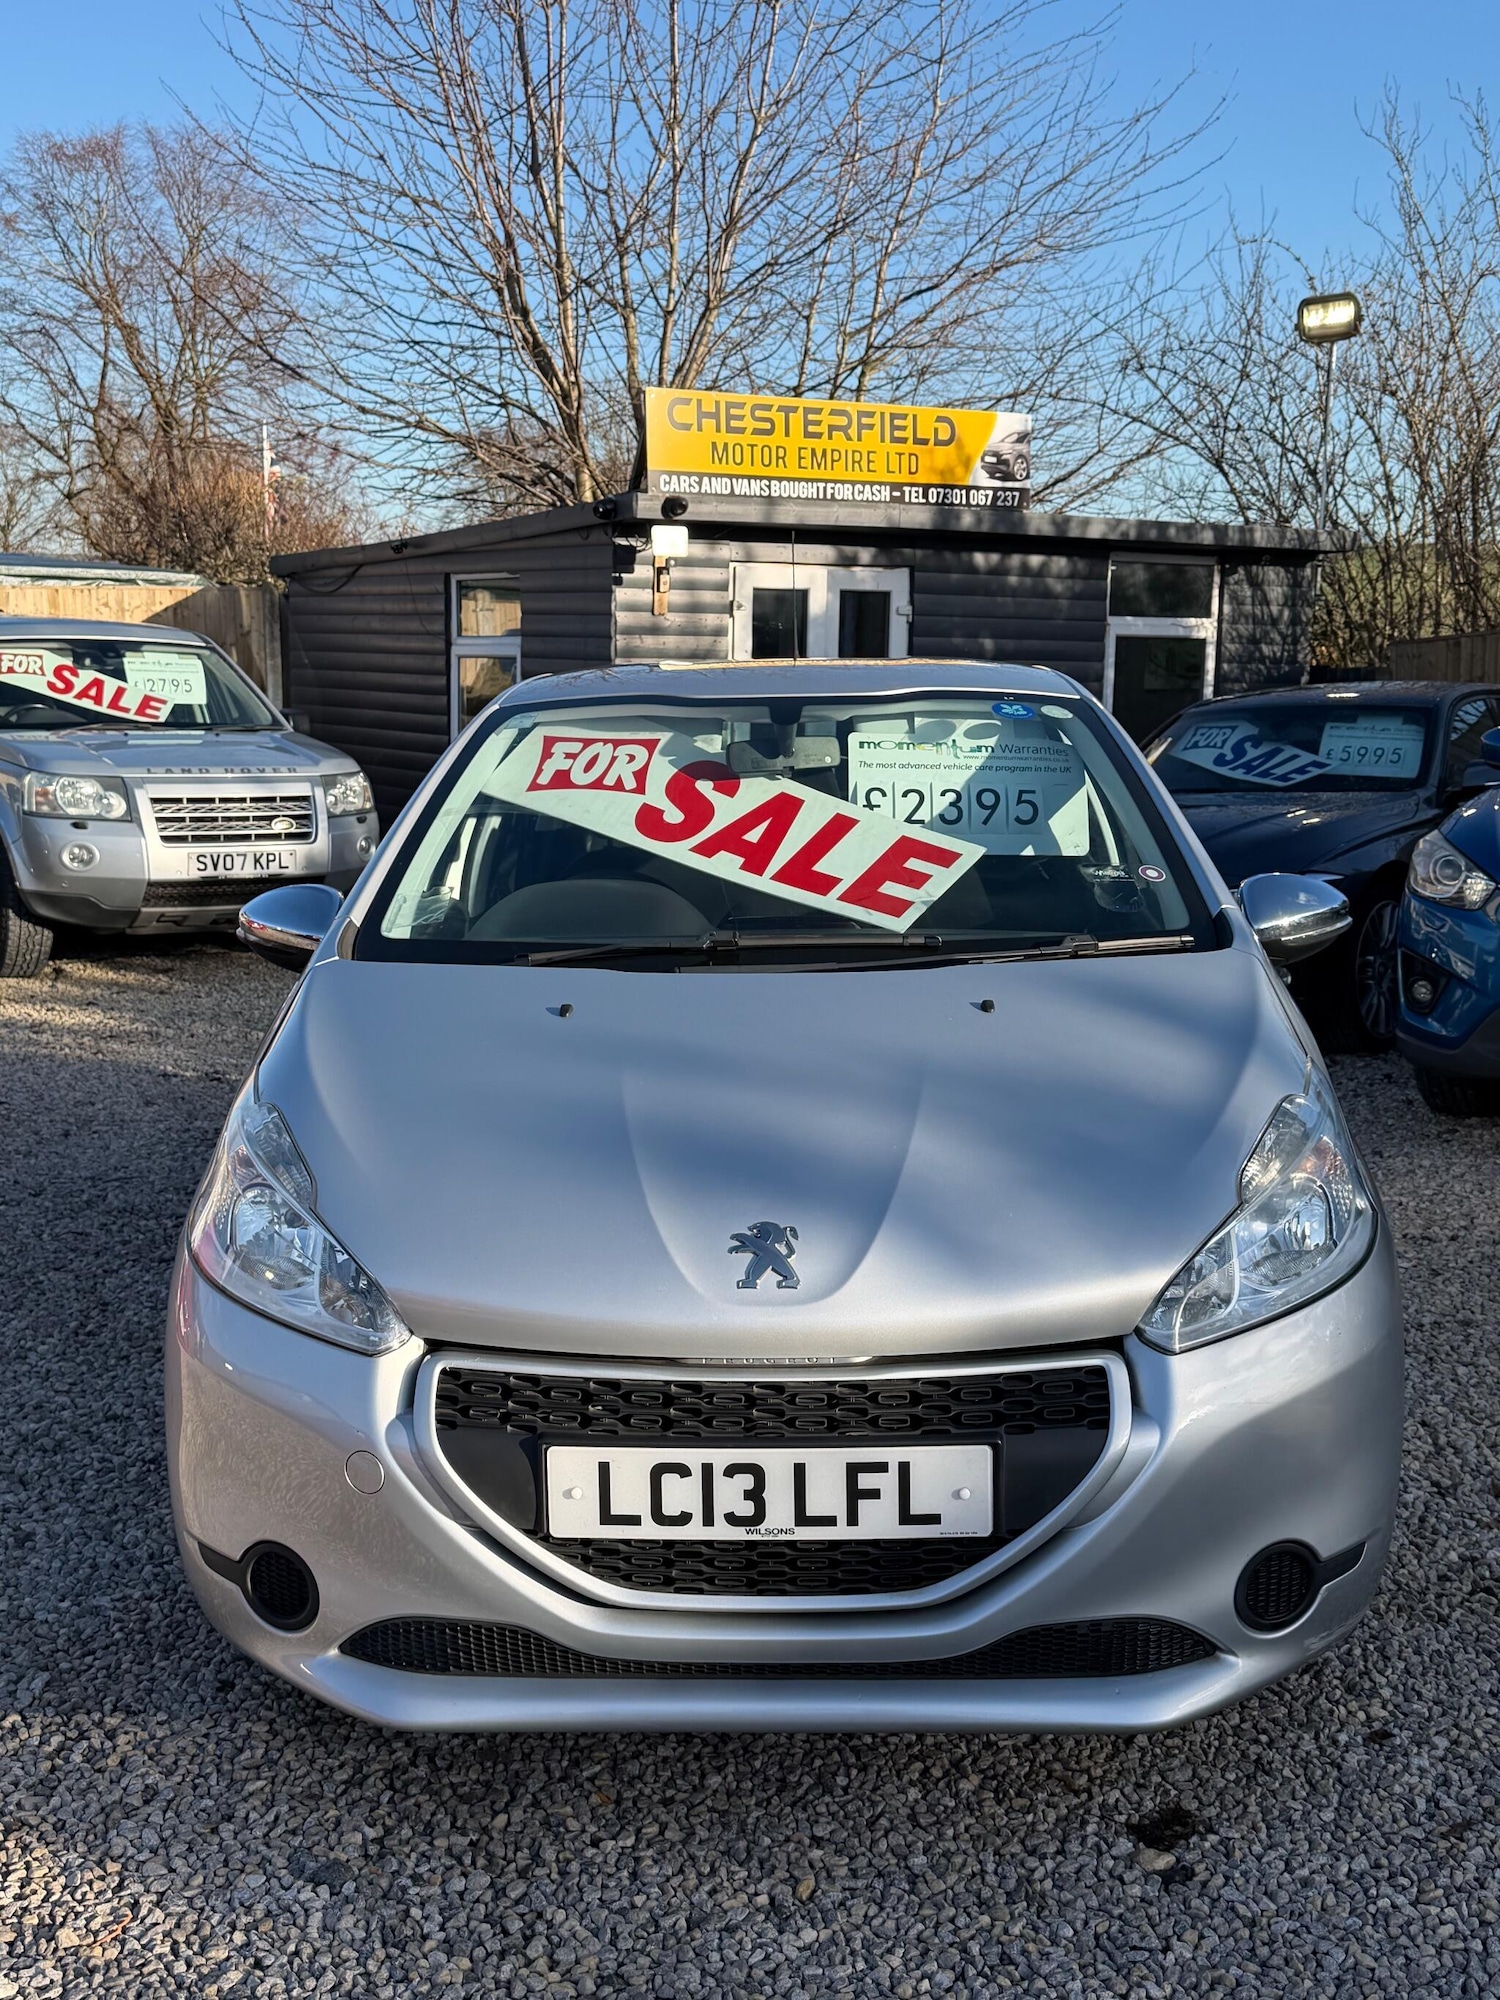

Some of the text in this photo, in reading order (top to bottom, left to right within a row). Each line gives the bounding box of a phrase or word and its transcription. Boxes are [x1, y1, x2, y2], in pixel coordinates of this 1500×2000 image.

[667, 397, 956, 447] CHESTERFIELD
[711, 441, 919, 476] MOTOR EMPIRE LTD
[659, 474, 699, 494] CARS
[701, 476, 731, 495] AND
[732, 478, 770, 497] VANS
[770, 480, 825, 499] BOUGHT
[827, 483, 851, 500] FOR
[853, 485, 890, 502] CASH
[903, 486, 926, 503] TEL
[928, 487, 966, 505] 07301
[969, 489, 993, 506] 067
[996, 491, 1020, 507] 237
[1, 654, 169, 721] FOR SALE
[858, 739, 1069, 759] momentum Warranties
[1187, 727, 1333, 783] FOR SALE
[1326, 745, 1403, 765] £5995
[858, 760, 874, 769] The
[875, 762, 897, 770] most
[899, 761, 941, 771] advanced
[943, 763, 973, 771] vehicle
[995, 765, 1033, 774] program
[1034, 765, 1042, 773] in
[1044, 765, 1057, 773] the
[1059, 766, 1072, 774] UK
[538, 741, 963, 919] FOR SALE
[196, 852, 289, 872] SV07 KPL
[597, 1461, 942, 1527] LC13 LFL
[744, 1527, 796, 1536] WILSONS
